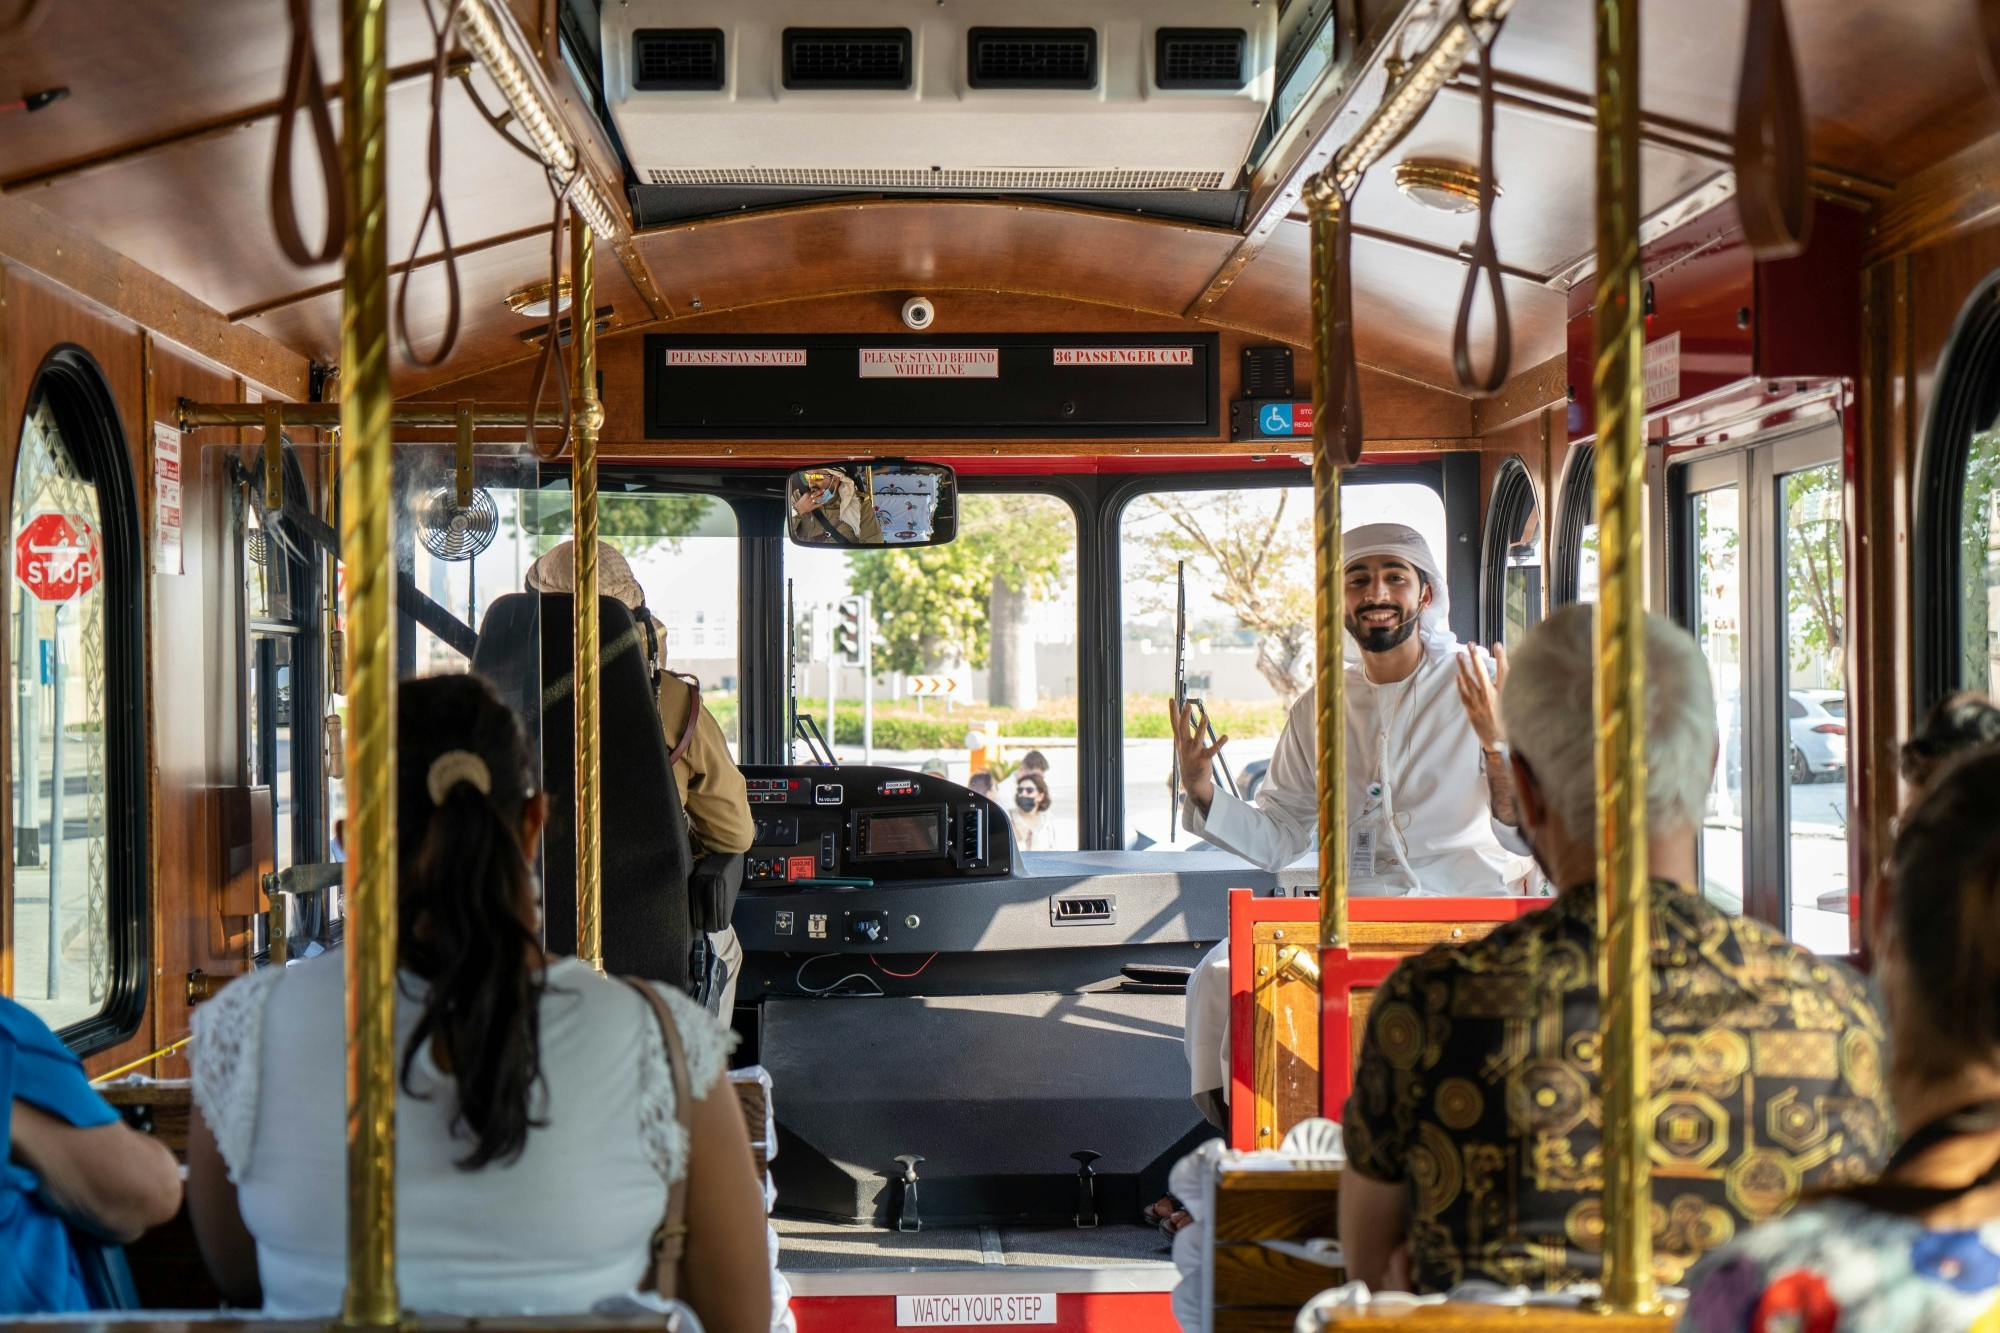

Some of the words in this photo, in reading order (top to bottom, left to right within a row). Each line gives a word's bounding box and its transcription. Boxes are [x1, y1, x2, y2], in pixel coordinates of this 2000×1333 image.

[671, 351, 719, 363] PLEASE
[720, 351, 750, 363] STAY
[754, 351, 802, 363] SEATED
[864, 352, 908, 363] PLEASE
[909, 352, 947, 363] STAND
[950, 352, 995, 363] BEHIND
[1056, 350, 1072, 362] 36
[1076, 350, 1156, 362] PASSENGER
[1160, 350, 1190, 362] CAP.
[894, 364, 935, 375] WHITE
[937, 364, 965, 375] LINE
[28, 561, 91, 584] STOP
[912, 1297, 960, 1323] WATCH
[964, 1297, 1003, 1322] YOUR
[1007, 1296, 1042, 1321] STEP
